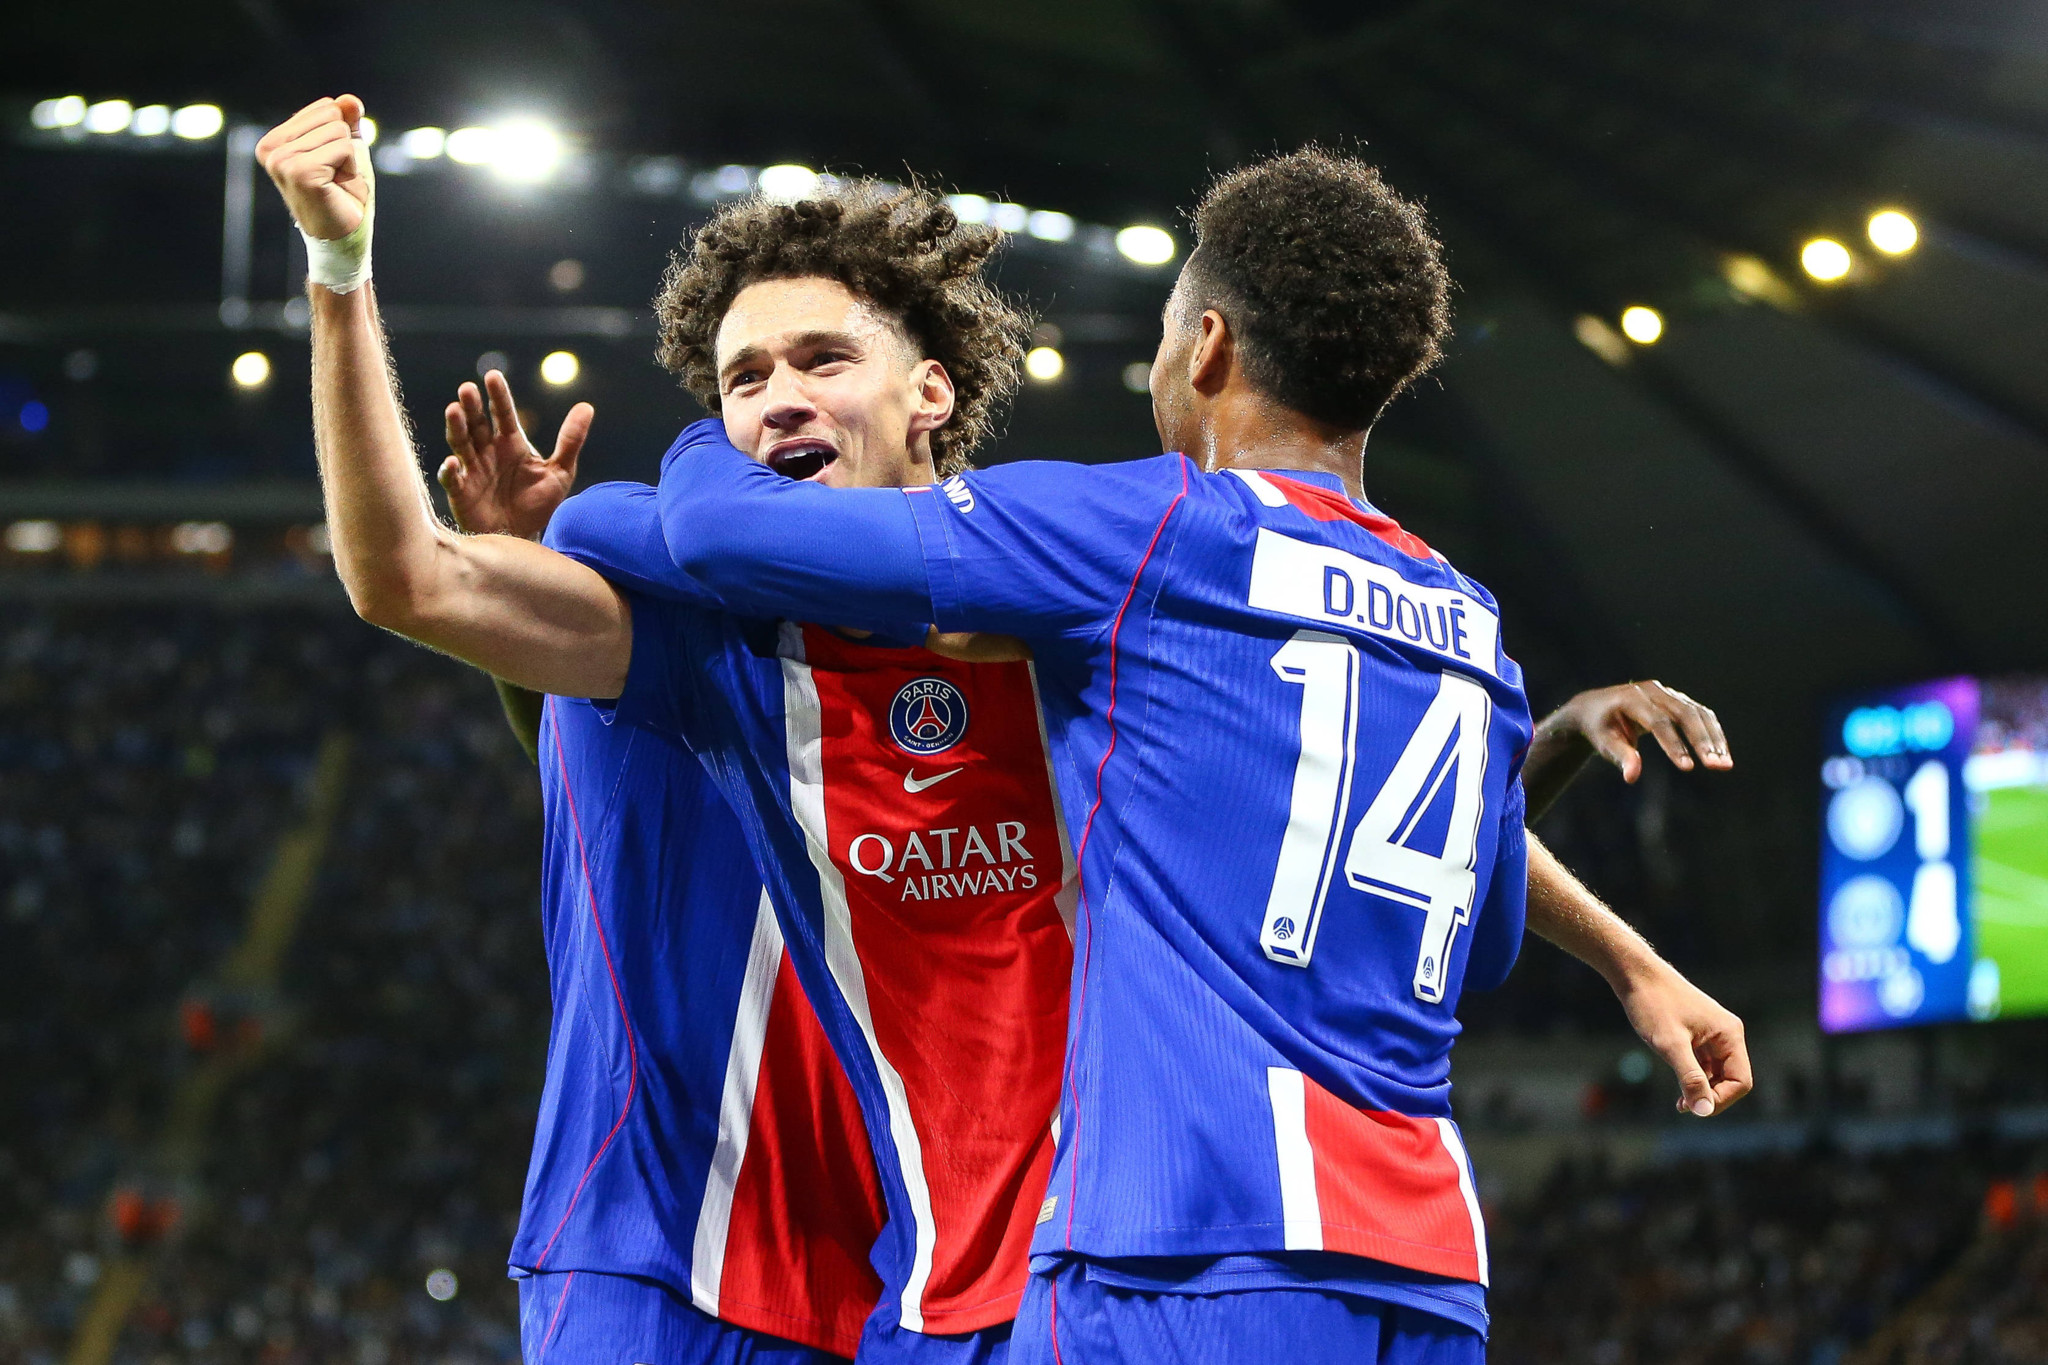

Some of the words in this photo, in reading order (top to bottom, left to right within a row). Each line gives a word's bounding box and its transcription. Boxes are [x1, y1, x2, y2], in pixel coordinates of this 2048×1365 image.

[1323, 565, 1471, 660] D.DOUÉ
[901, 682, 952, 703] PARIS
[1259, 629, 1492, 1005] 14
[848, 821, 1034, 883] QATAR
[901, 864, 1038, 901] AIRWAYS
